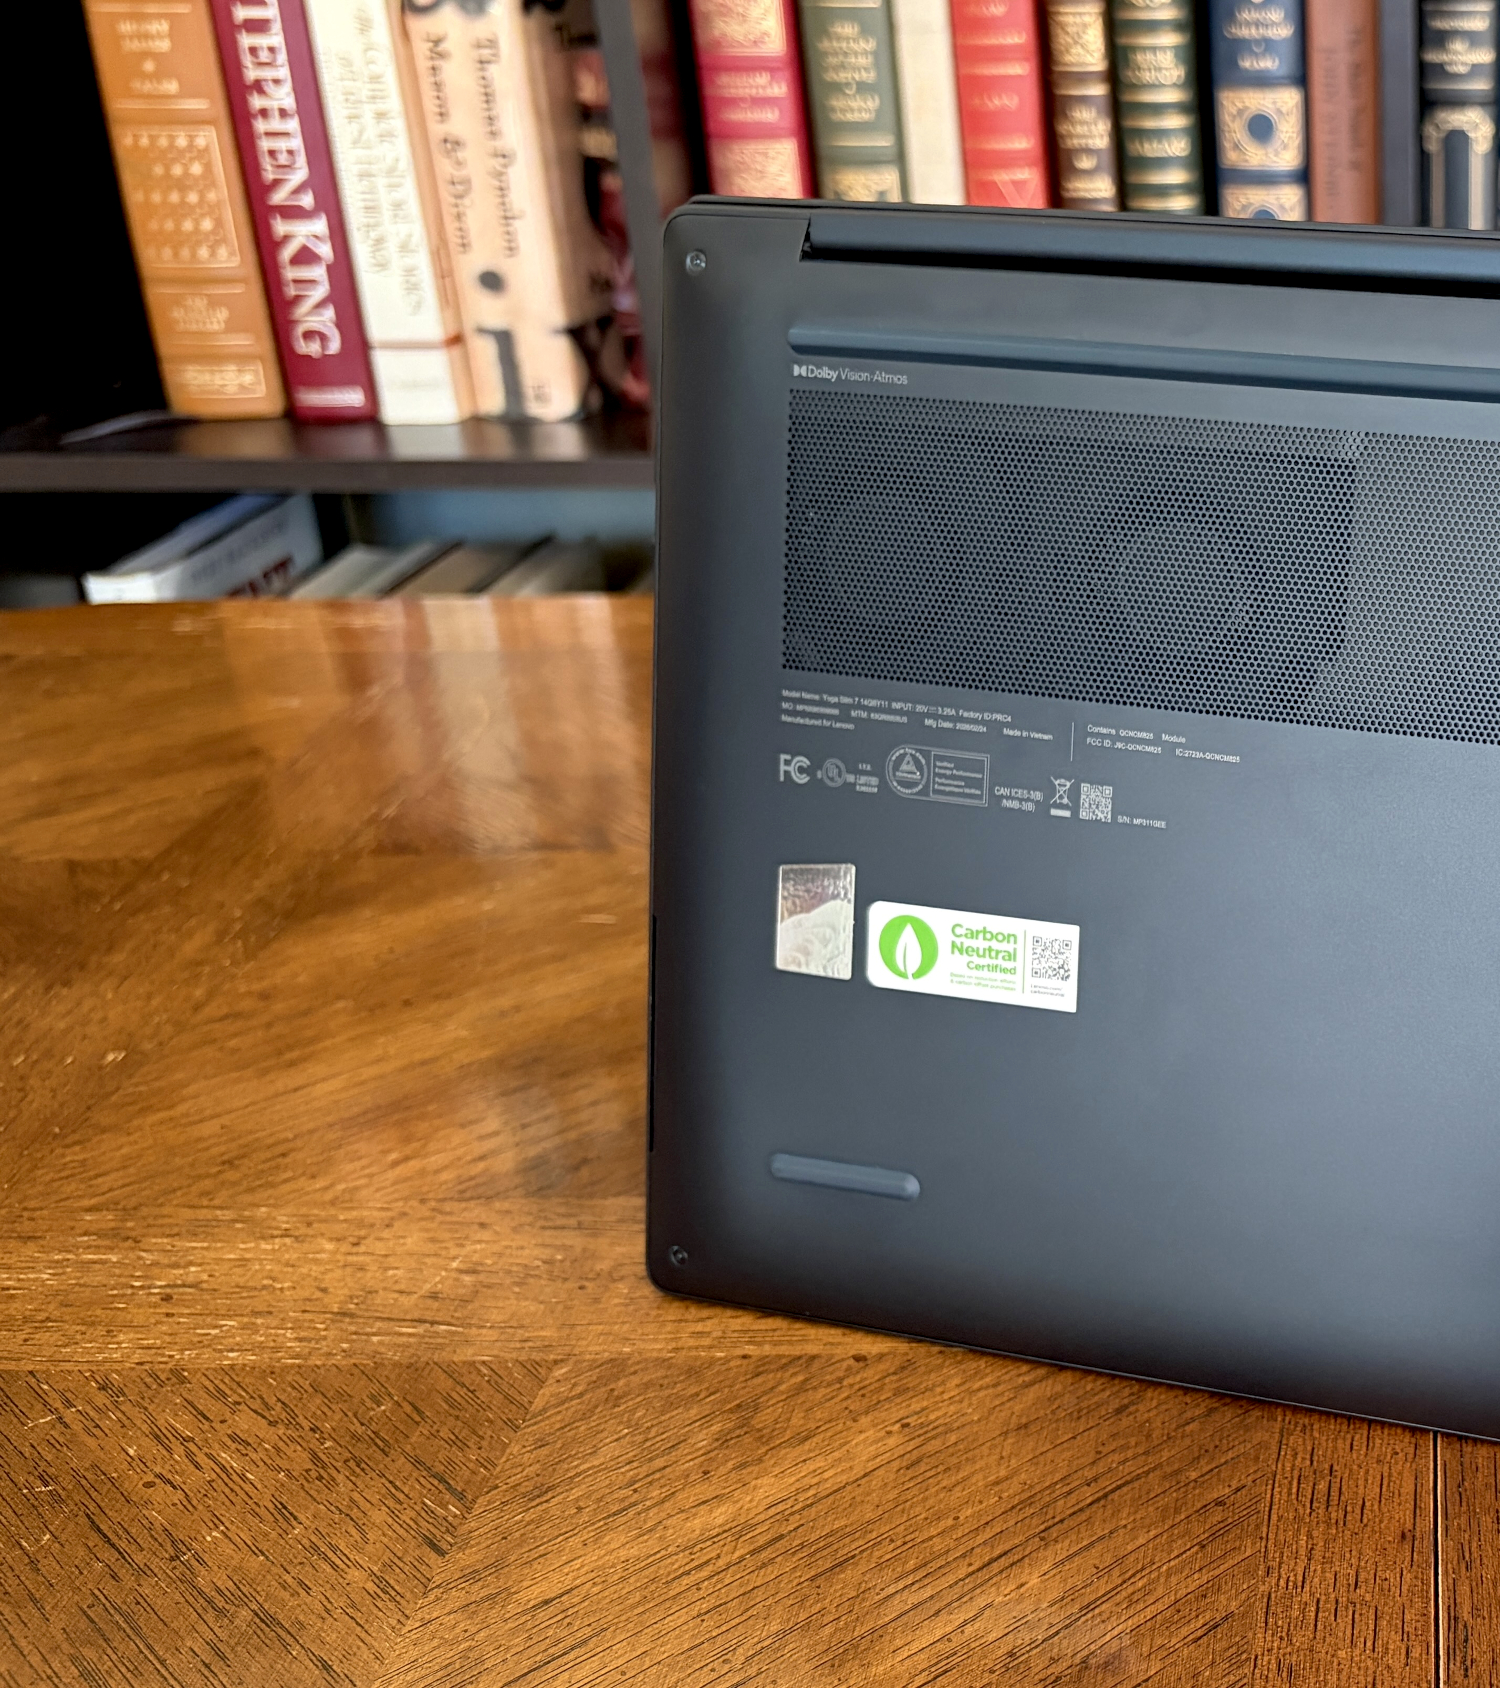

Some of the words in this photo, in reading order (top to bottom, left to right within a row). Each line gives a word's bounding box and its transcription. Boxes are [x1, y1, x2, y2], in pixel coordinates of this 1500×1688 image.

[272, 210, 342, 358] KING
[808, 365, 838, 382] Dolby
[782, 689, 801, 699] Model
[823, 693, 839, 704] Yoga
[891, 701, 915, 711] INPUT:
[959, 709, 982, 721] Factory
[781, 713, 822, 727] Manufactured
[822, 718, 832, 727] for
[832, 719, 855, 730] Lenovo
[924, 717, 937, 728] Mfg
[938, 719, 955, 730] Date:
[1003, 727, 1022, 737] Made
[1029, 731, 1054, 741] Vietnam
[1086, 737, 1102, 747] FCC
[1103, 739, 1113, 748] ID:
[1087, 724, 1116, 736] Contains
[1161, 732, 1186, 744] Module
[994, 786, 1010, 797] CAN
[1011, 788, 1044, 801] ICES-3(B)
[1001, 799, 1036, 813] /NMB-3(B)
[1117, 815, 1132, 825] S/N:
[951, 923, 1018, 945] Carbon
[950, 940, 1017, 963] Neutral
[966, 960, 1017, 975] Certified
